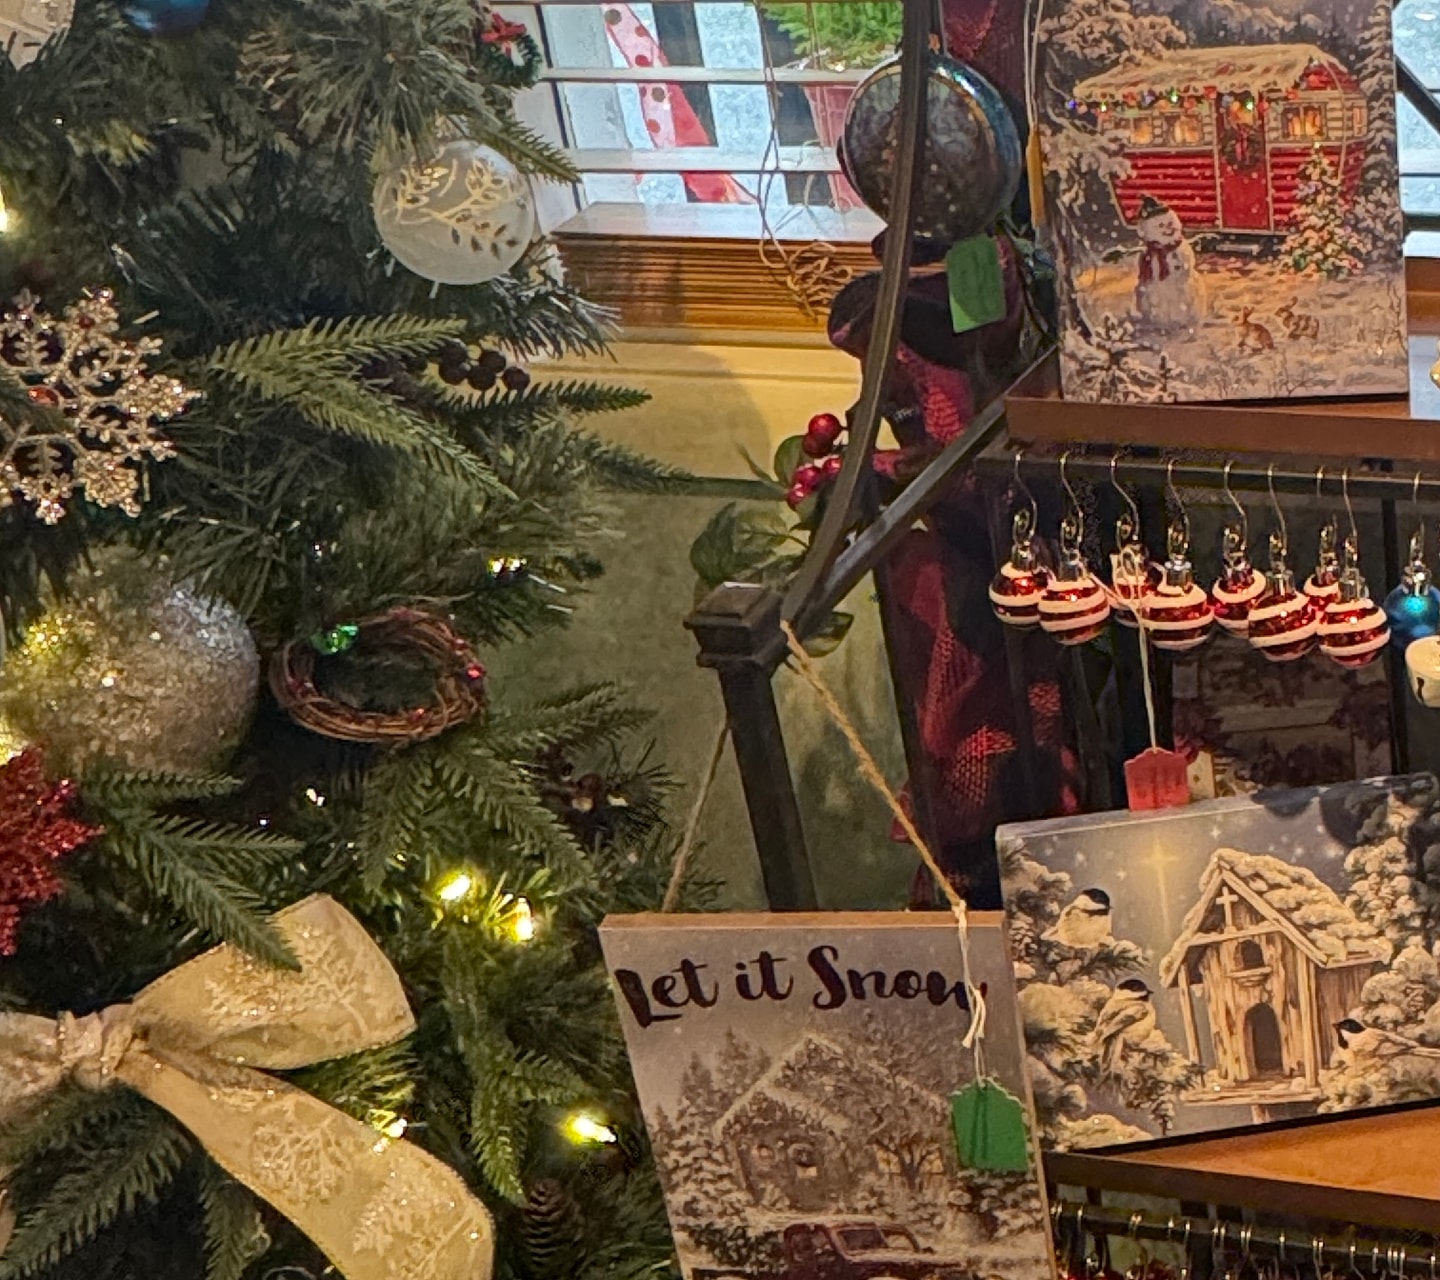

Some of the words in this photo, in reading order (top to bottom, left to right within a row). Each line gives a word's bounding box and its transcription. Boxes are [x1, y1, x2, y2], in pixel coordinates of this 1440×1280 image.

[614, 958, 719, 1029] Let
[735, 951, 793, 1001] it
[807, 945, 988, 1011] Snow
